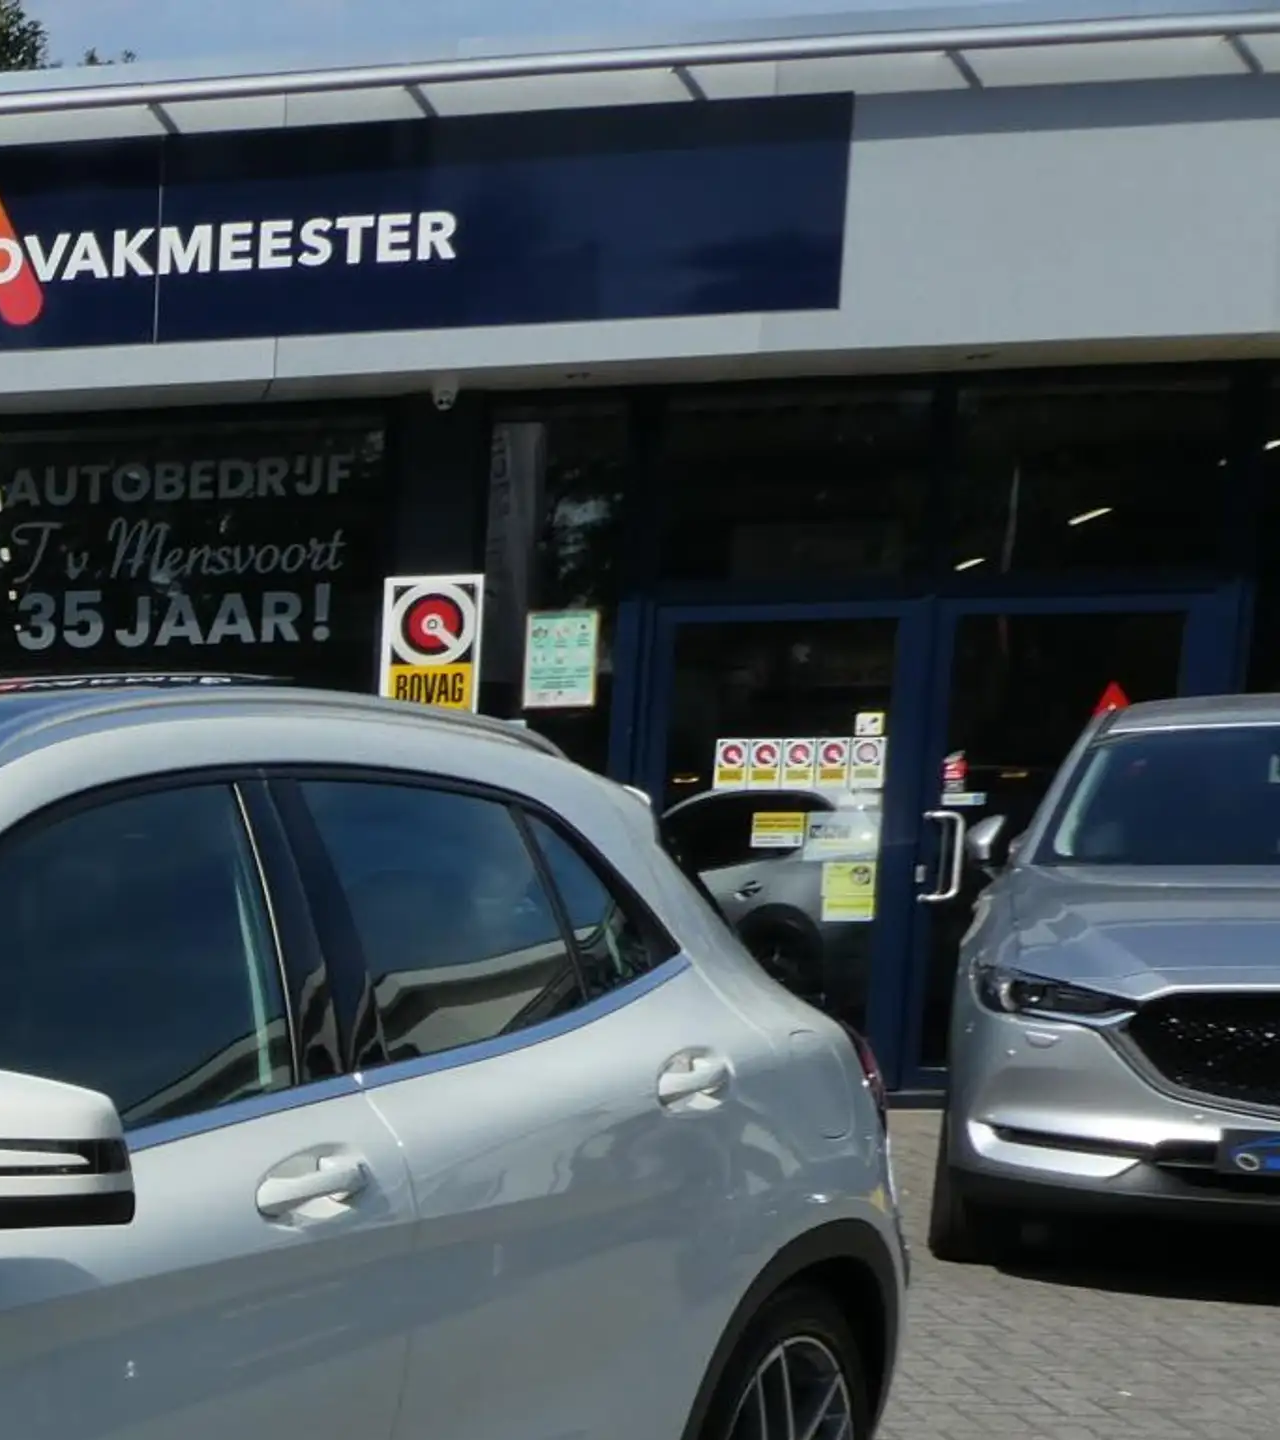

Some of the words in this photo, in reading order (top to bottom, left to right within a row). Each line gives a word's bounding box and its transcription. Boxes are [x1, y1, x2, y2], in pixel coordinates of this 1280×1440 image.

[4, 453, 355, 508] AUTOBEDRIJF
[107, 516, 347, 579] Mensvoort
[16, 589, 104, 651] 35
[114, 583, 331, 648] JAAR!
[395, 672, 464, 703] BOVAG
